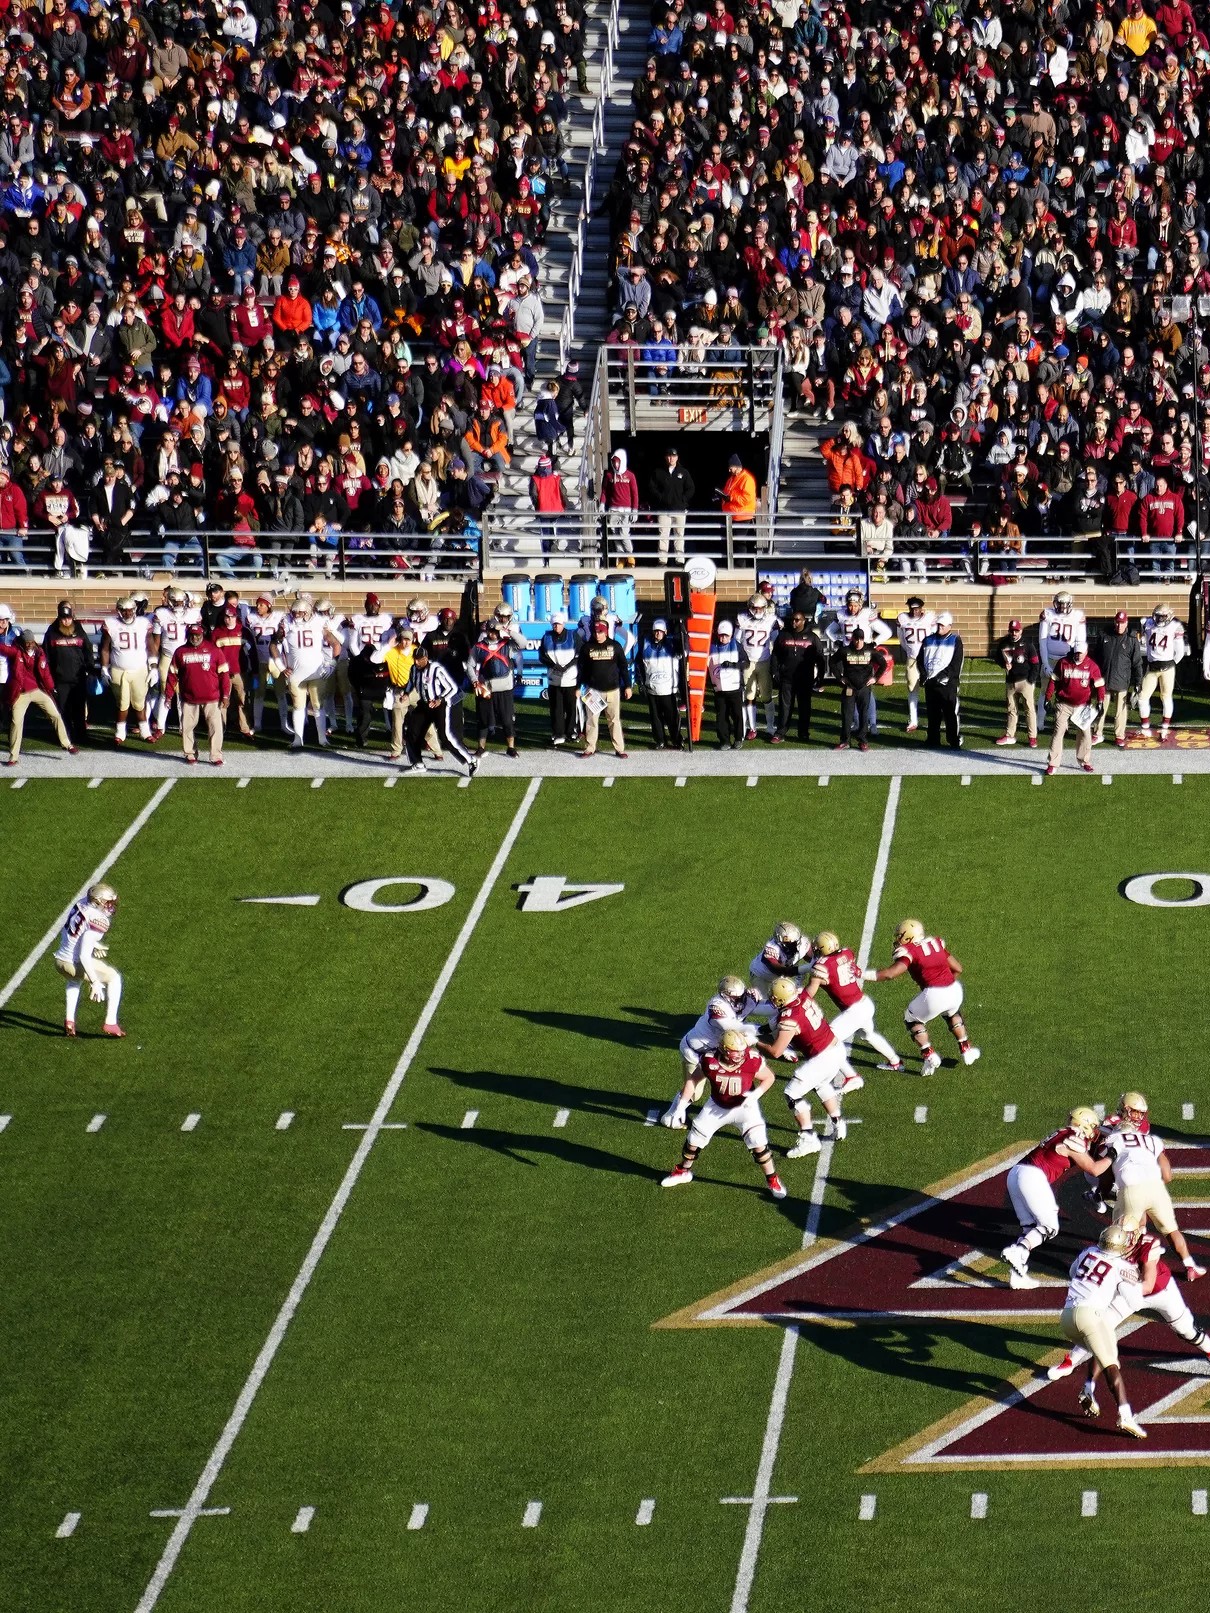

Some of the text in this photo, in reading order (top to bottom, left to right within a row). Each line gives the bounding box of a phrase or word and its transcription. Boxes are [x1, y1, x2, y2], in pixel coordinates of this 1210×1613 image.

[683, 409, 703, 423] EXIT
[672, 576, 683, 602] 1
[118, 631, 139, 651] 91
[297, 630, 314, 649] 16
[360, 626, 384, 645] 55
[744, 630, 768, 647] 22
[904, 627, 927, 644] 20
[1050, 621, 1073, 643] 30
[1148, 631, 1169, 652] 44
[715, 1075, 743, 1097] 70
[1121, 1133, 1157, 1157] 90
[1075, 1252, 1114, 1287] 58
